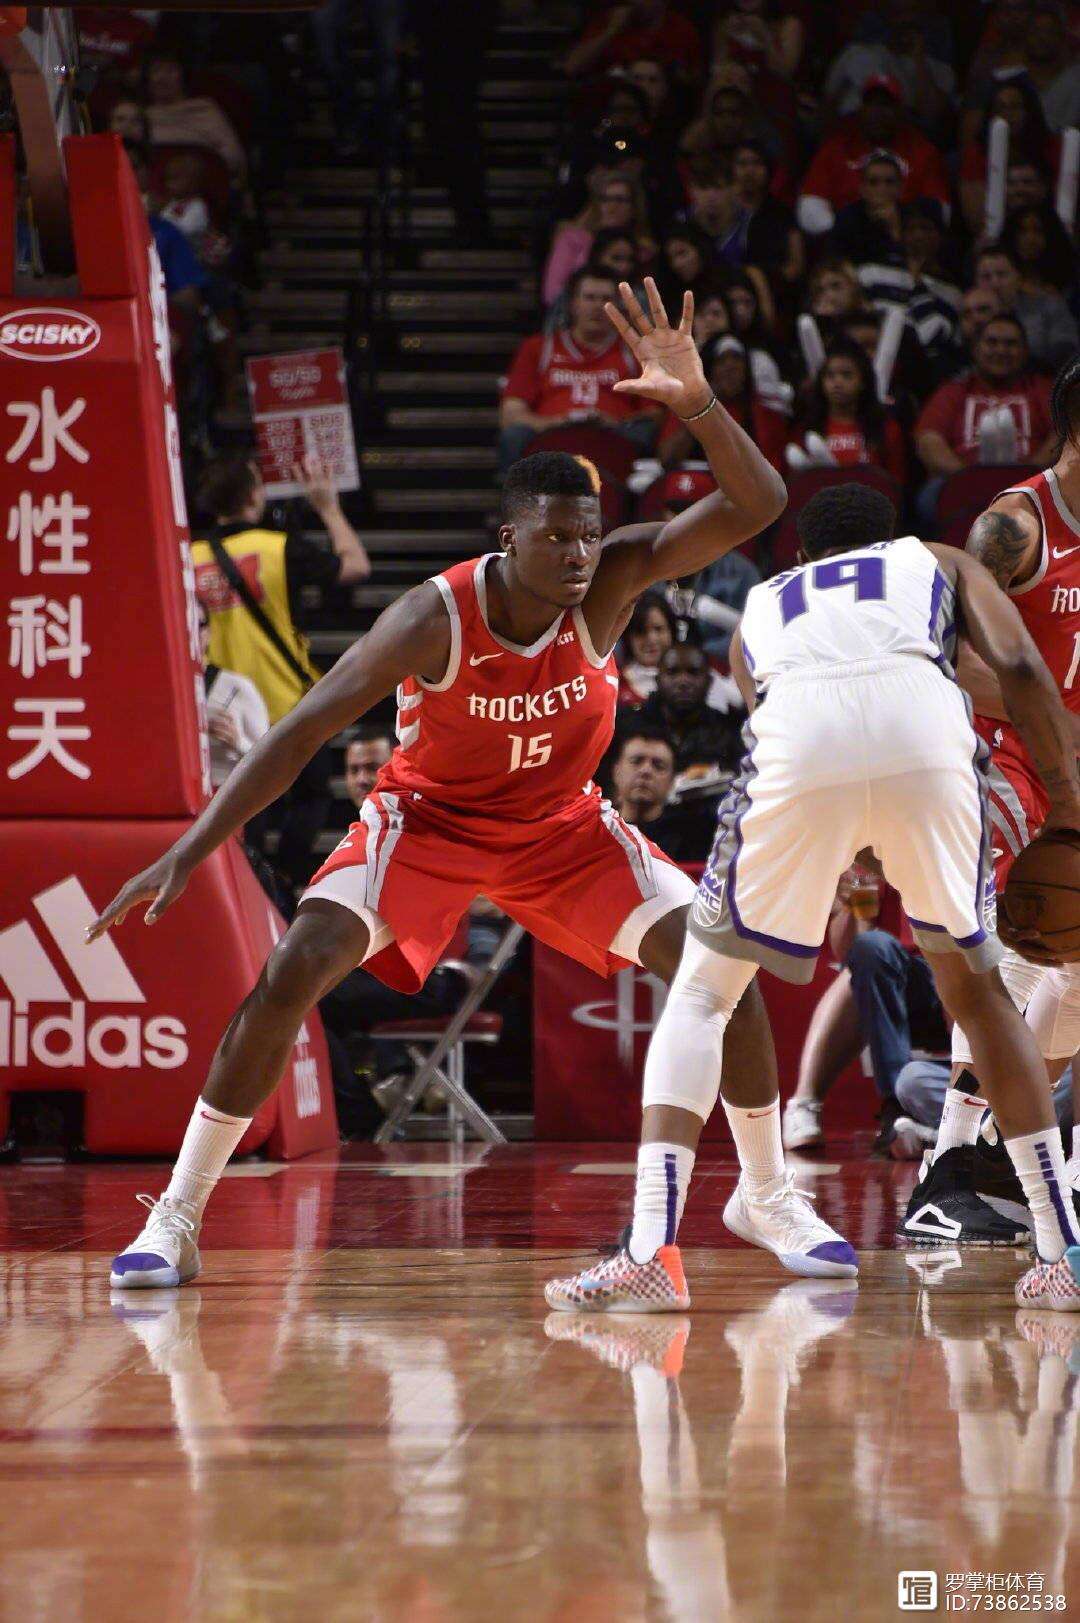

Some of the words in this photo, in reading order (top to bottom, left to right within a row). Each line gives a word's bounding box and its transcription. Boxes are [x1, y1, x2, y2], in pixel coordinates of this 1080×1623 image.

[0, 324, 94, 345] SCISKY
[6, 385, 92, 780] 水性科天
[776, 556, 887, 630] 19
[466, 675, 588, 722] ROCKETS
[507, 732, 553, 775] 15
